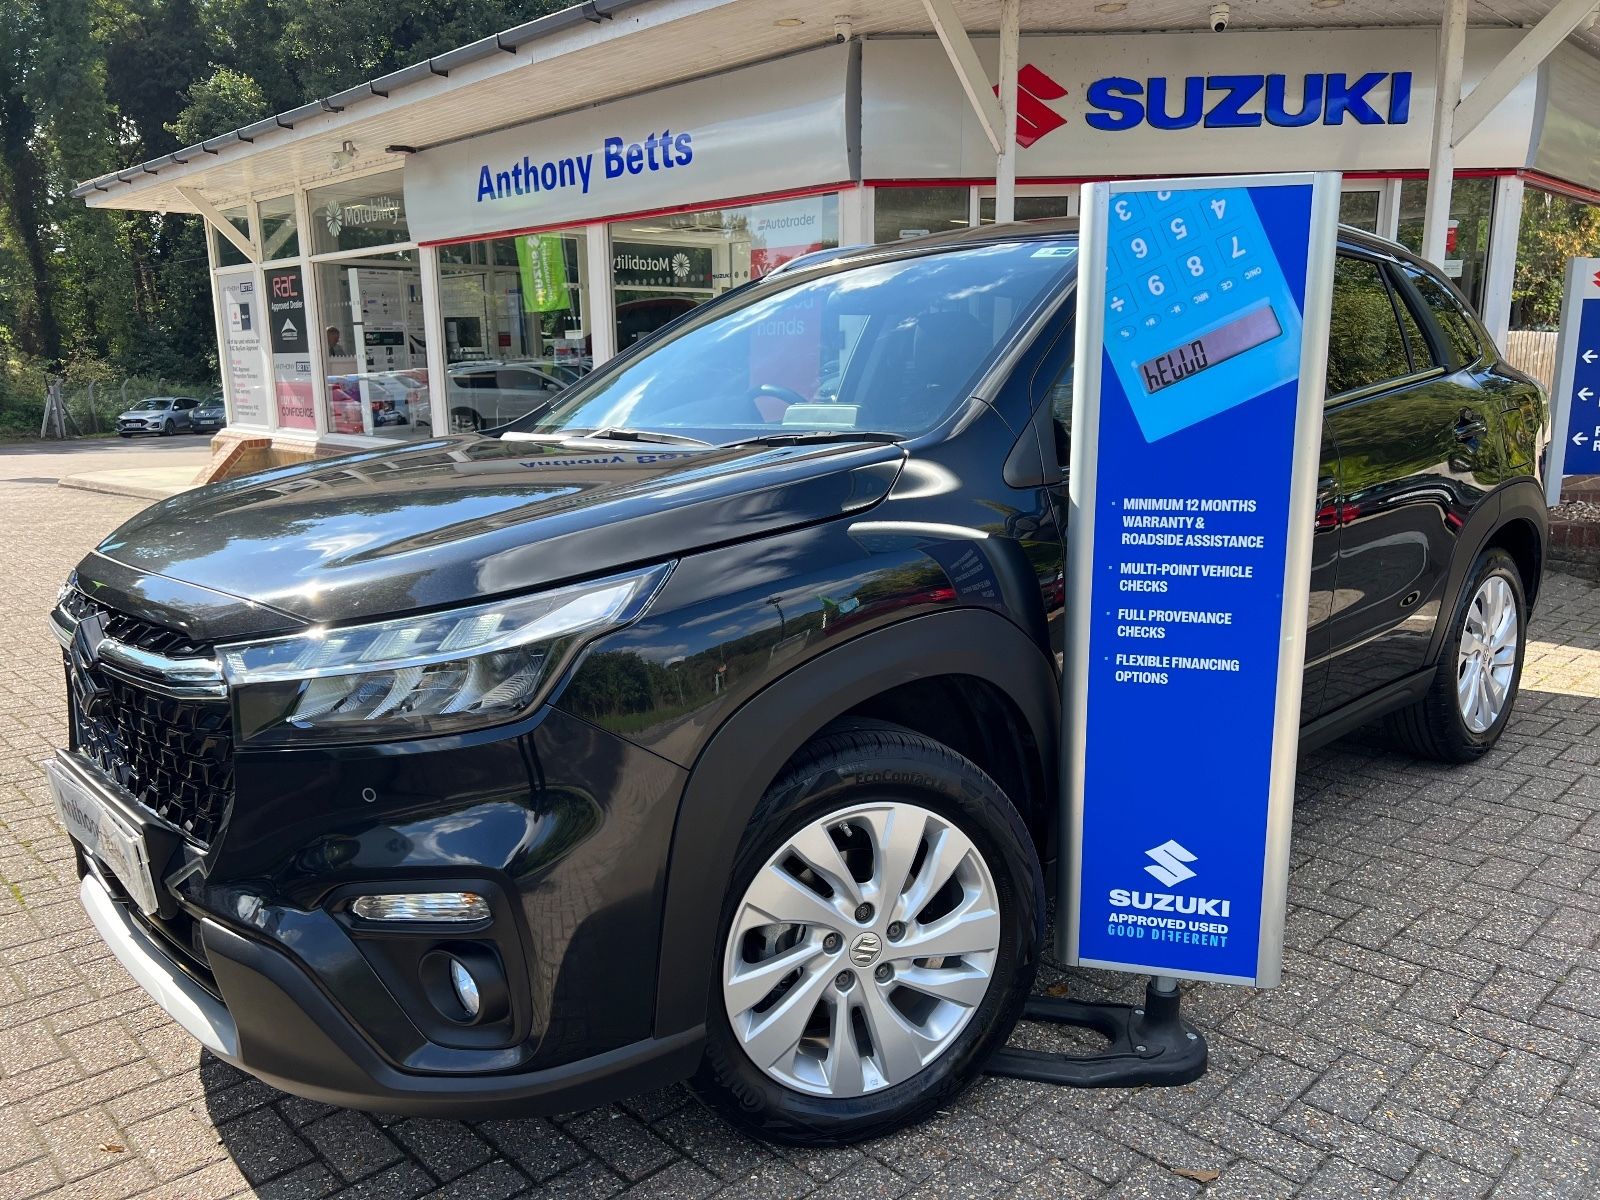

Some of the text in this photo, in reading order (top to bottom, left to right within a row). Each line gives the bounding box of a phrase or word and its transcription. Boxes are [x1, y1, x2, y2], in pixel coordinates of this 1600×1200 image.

[1085, 72, 1412, 131] SUZUKI
[477, 129, 693, 202] Anthony Betts
[345, 196, 399, 227] Motability
[1210, 199, 1226, 219] 4
[765, 213, 816, 231] Autotrader
[1170, 217, 1188, 240] 5
[1231, 236, 1246, 259] 7
[1186, 256, 1204, 276] 8
[271, 300, 304, 313] Approved Dealer
[282, 406, 314, 418] CONFIDENCE
[1123, 498, 1257, 512] MINIMUM 12 MONTHS
[1123, 515, 1205, 529] WARRANTY &
[1122, 533, 1264, 548] ROADSIDE ASSISTANCE
[1120, 562, 1253, 578] MULTI-POINT VEHICLE
[1119, 579, 1168, 592] CHECKS
[1118, 608, 1232, 624] FULL PROVENANCE
[1117, 625, 1166, 638] CHECKS
[1116, 653, 1240, 671] FLEXIBLE FINANCING
[1115, 670, 1168, 684] OPTIONS
[1109, 889, 1230, 917] SUZUKI
[1108, 912, 1228, 934] APPROVED USED
[1108, 924, 1228, 947] GOOD DIFFERENT
